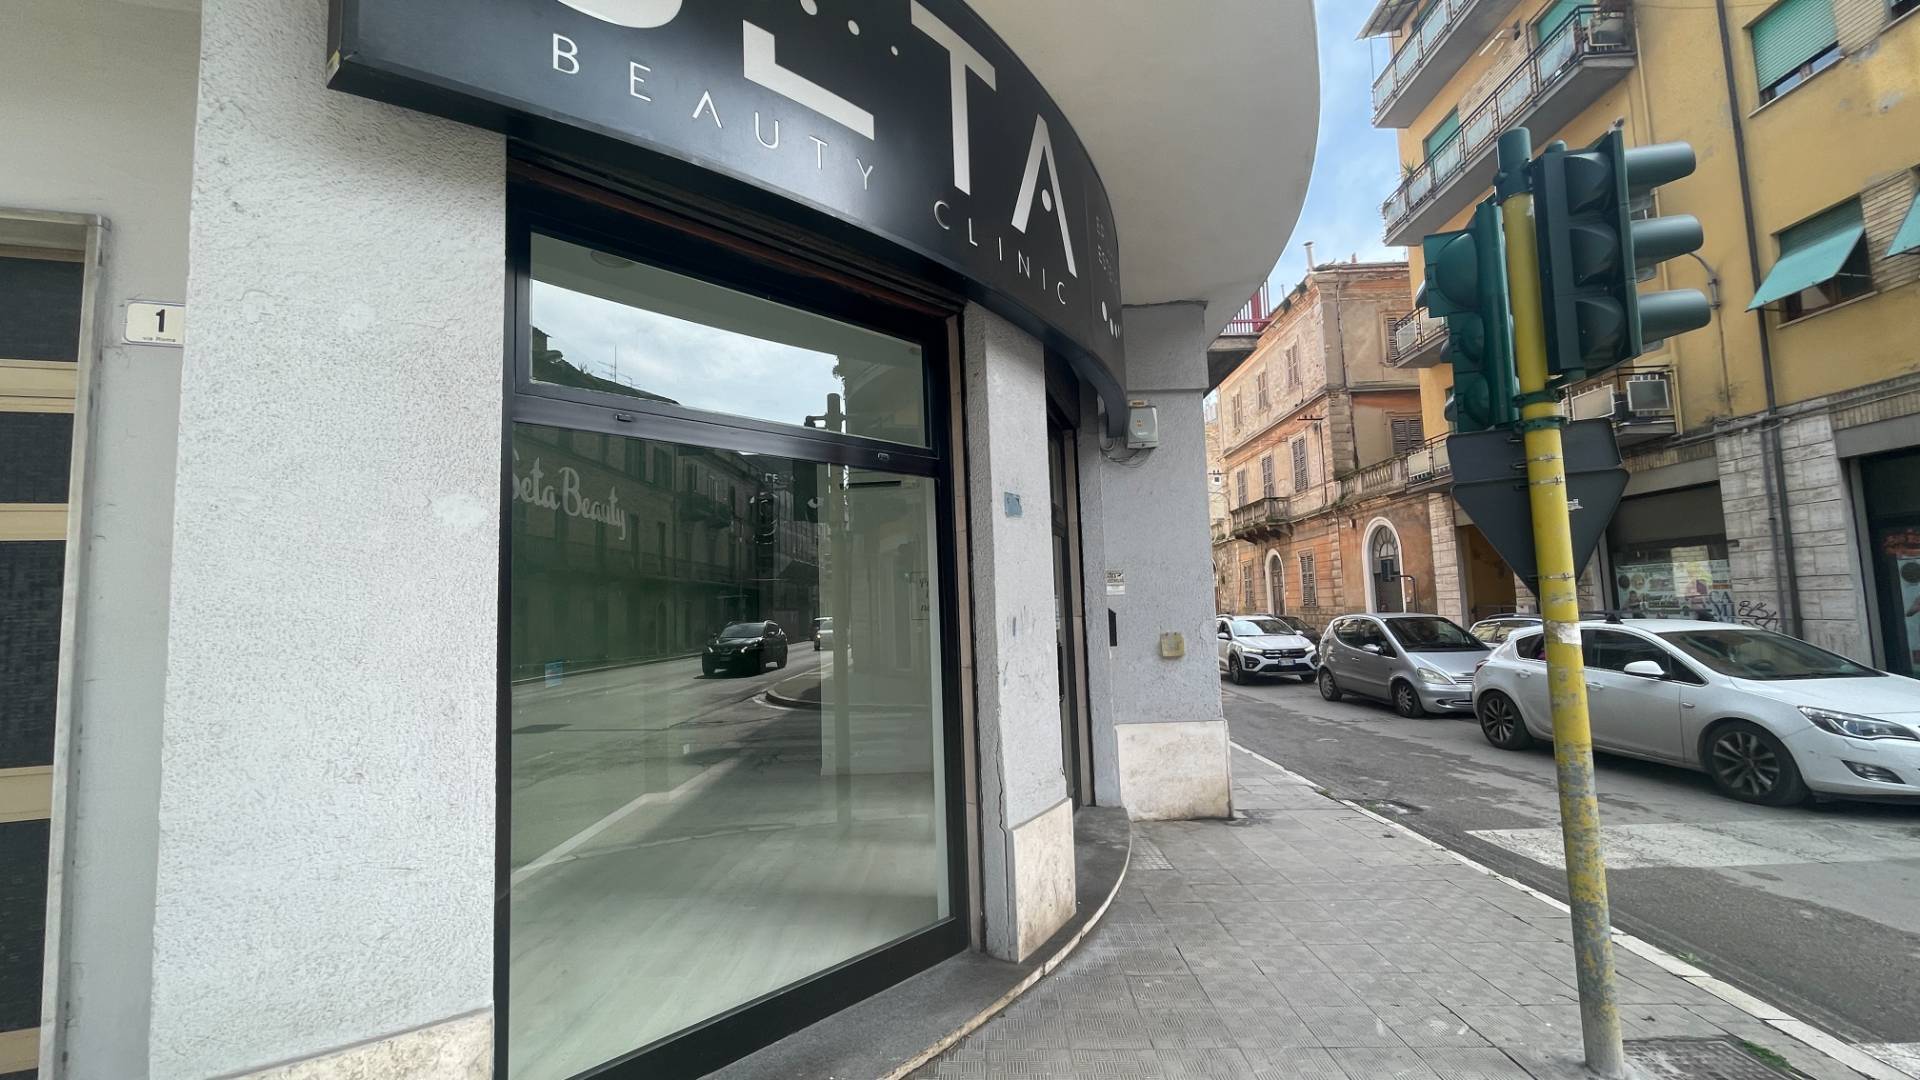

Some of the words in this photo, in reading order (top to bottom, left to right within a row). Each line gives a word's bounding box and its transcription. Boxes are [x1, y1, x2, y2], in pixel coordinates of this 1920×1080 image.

[552, 33, 873, 190] BEAUTY
[934, 200, 1066, 305] CLINIC
[557, 0, 1078, 279] TA
[155, 309, 166, 333] 1
[560, 467, 626, 540] Beauty
